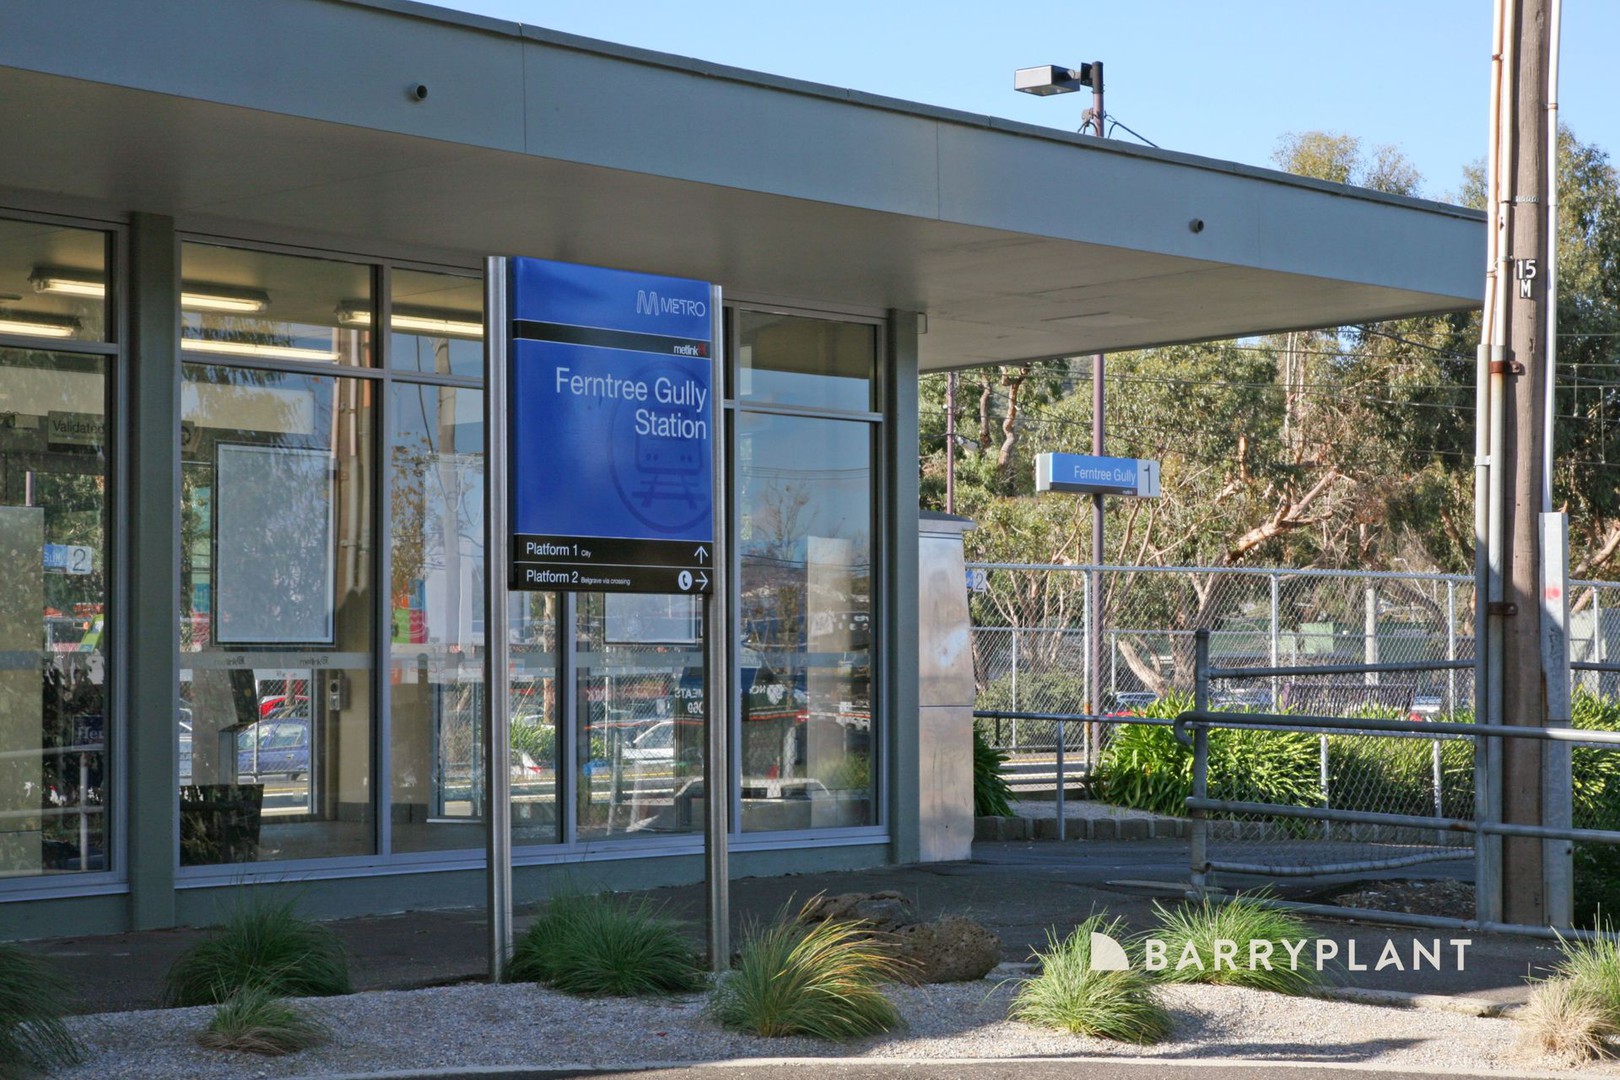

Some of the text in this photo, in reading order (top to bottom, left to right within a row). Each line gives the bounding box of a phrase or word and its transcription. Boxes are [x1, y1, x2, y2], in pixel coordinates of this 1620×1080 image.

[1517, 259, 1537, 279] 15
[1520, 279, 1532, 298] M
[660, 297, 706, 317] METRO
[673, 344, 699, 357] metlink
[555, 366, 708, 413] Ferntree Gully
[634, 408, 707, 440] Station
[1073, 463, 1151, 494] Ferntree Gully 1
[525, 541, 570, 556] Platform
[572, 543, 578, 557] 1
[72, 548, 86, 572] 2
[525, 569, 570, 583] Platform
[571, 570, 579, 584] 2
[975, 572, 984, 590] 2
